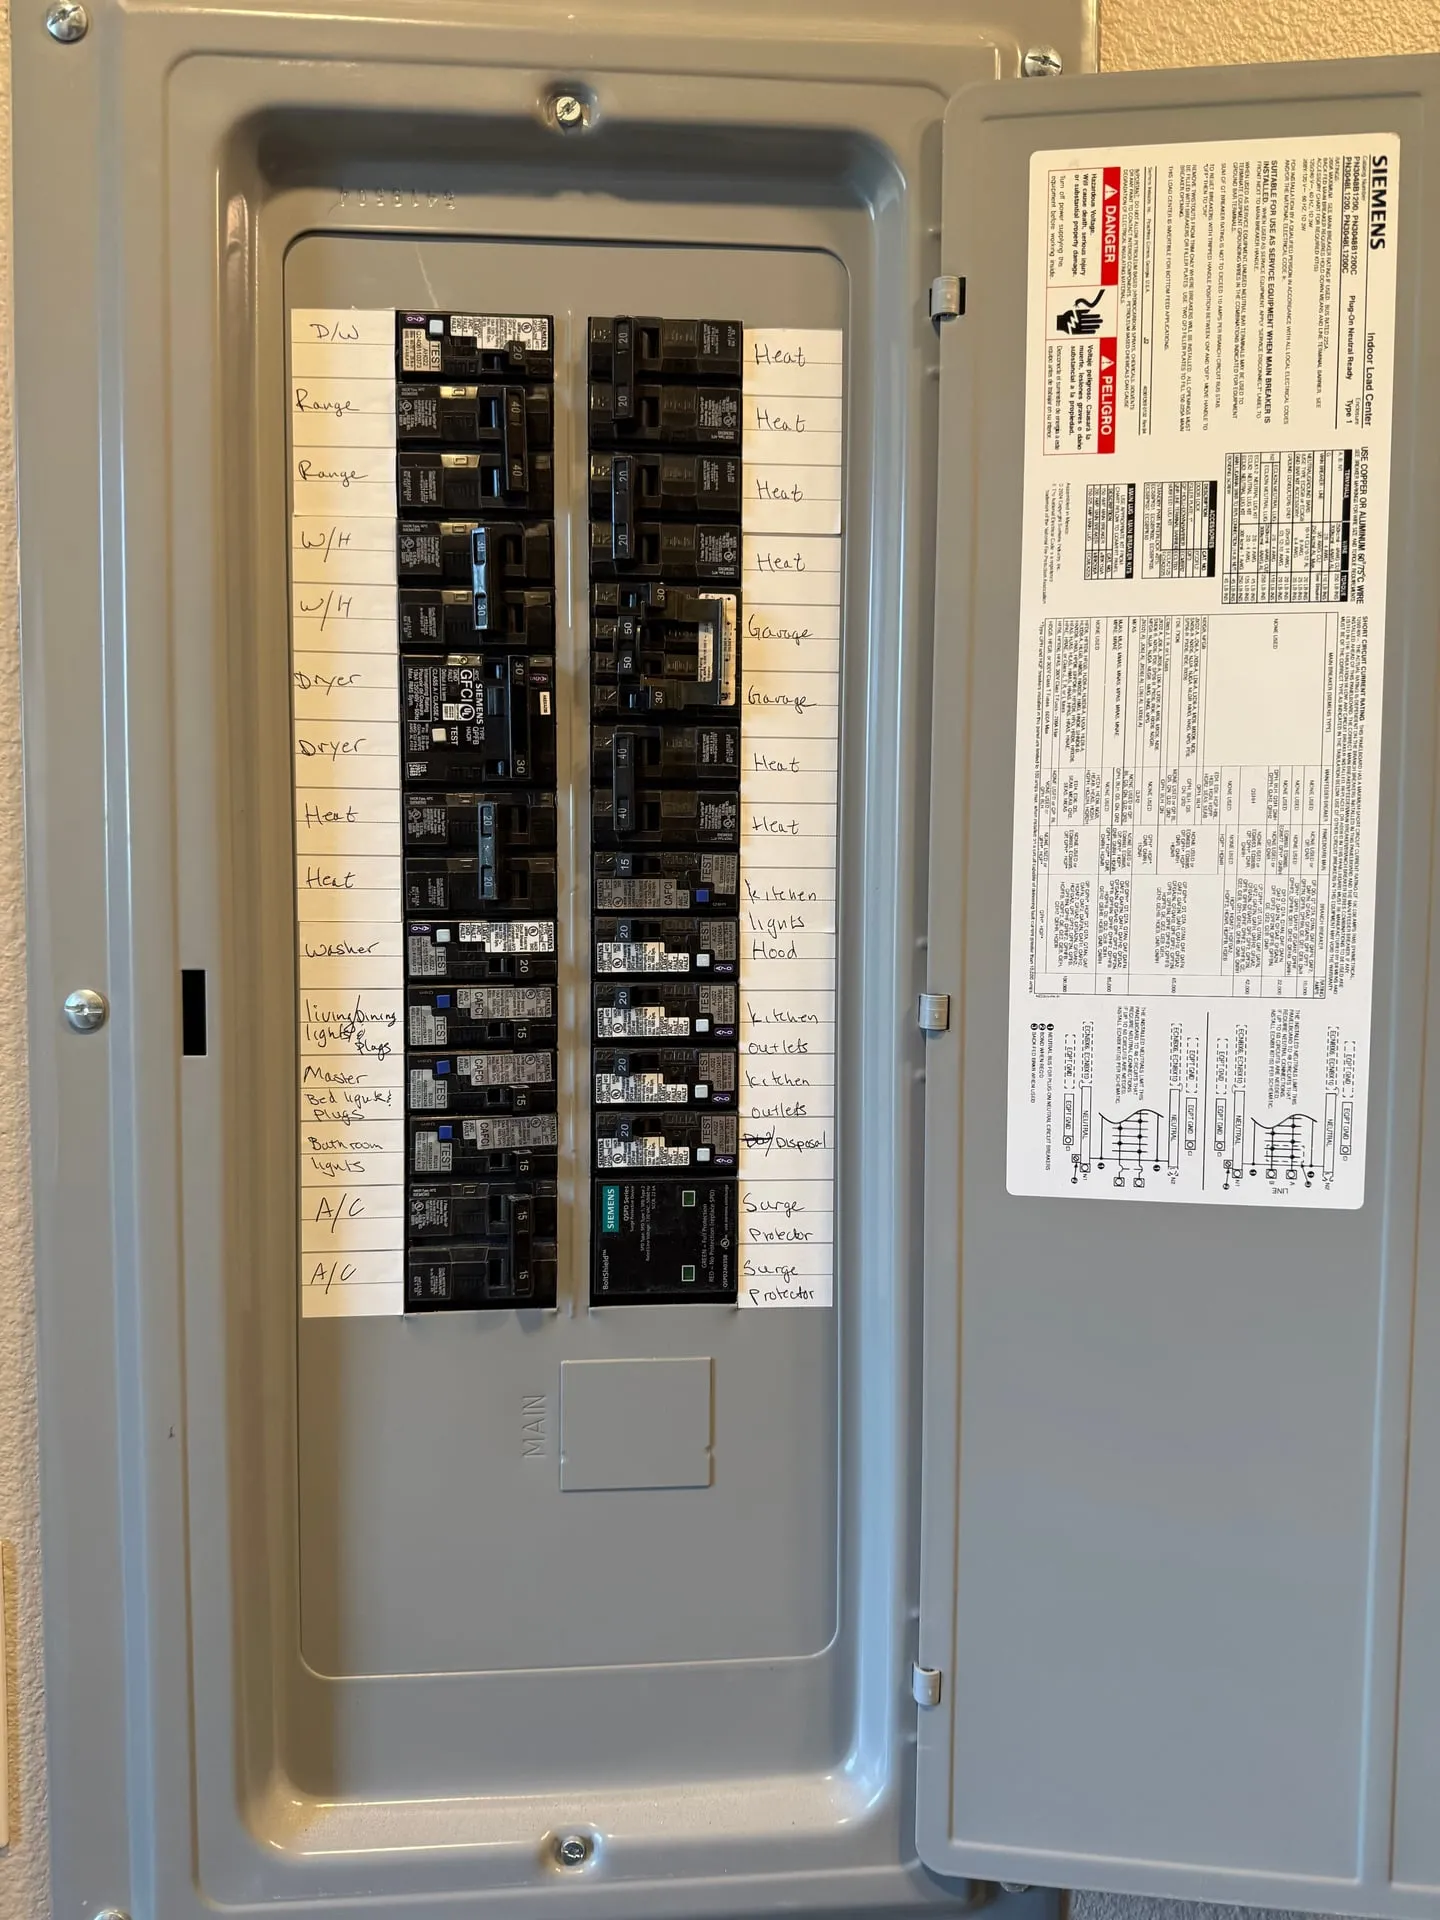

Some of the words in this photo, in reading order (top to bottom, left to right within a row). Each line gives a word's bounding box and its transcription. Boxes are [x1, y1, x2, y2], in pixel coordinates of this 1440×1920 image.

[1262, 161, 1270, 204] INSTALLED.
[1270, 160, 1278, 198] SUITABLE
[1370, 155, 1388, 250] SIEMENS
[1080, 210, 1088, 230] death,
[1269, 218, 1277, 234] USE
[1071, 221, 1080, 247] property
[1105, 205, 1116, 263] DANGER
[1269, 235, 1276, 246] AS
[1071, 250, 1079, 277] damage.
[1268, 248, 1276, 281] SERVICE
[1266, 283, 1275, 328] EQUIPMENT
[1347, 295, 1356, 326] Plug-On
[310, 322, 359, 340] D/W
[618, 332, 628, 344] 20
[1347, 327, 1355, 355] Neutral
[432, 344, 440, 370] TEST
[513, 345, 523, 360] 20
[755, 343, 806, 367] Heat
[1077, 345, 1085, 370] muerte,
[1085, 345, 1093, 367] Voltaje
[1366, 332, 1375, 364] Indoor
[1346, 357, 1354, 380] Ready
[1365, 367, 1375, 391] Load
[1085, 369, 1093, 401] peligroso.
[296, 388, 360, 418] Range
[511, 401, 521, 413] 40
[618, 395, 627, 407] 20
[1101, 375, 1113, 435] PELIGRO
[1345, 400, 1353, 417] Type
[1364, 394, 1374, 425] Center
[757, 407, 805, 433] Heat
[1068, 400, 1076, 435] propiedad.
[1076, 402, 1084, 424] graves
[1085, 404, 1093, 431] Causará
[1360, 446, 1368, 461] USE
[299, 461, 368, 487] Range
[513, 464, 522, 476] 40
[618, 470, 627, 482] 20
[1359, 463, 1368, 493] COPPER
[757, 479, 803, 502] Heat
[1359, 496, 1367, 508] OR
[618, 534, 628, 546] 20
[1358, 511, 1366, 551] ALUMINUM
[301, 527, 351, 562] W/H
[478, 540, 485, 552] 30
[757, 553, 806, 573] Heat
[657, 588, 665, 600] 30
[1356, 585, 1365, 604] WIRE
[478, 605, 486, 616] 30
[624, 622, 632, 634] 50
[748, 614, 814, 645] Garage
[516, 662, 524, 675] 30
[623, 656, 632, 668] 50
[294, 671, 362, 695] Dryer
[460, 669, 472, 702] GFCI
[655, 692, 663, 703] 30
[748, 685, 817, 714] Garage
[299, 739, 366, 762] Dryer
[618, 748, 627, 759] 40
[516, 760, 525, 773] 30
[754, 753, 800, 773] Heat
[305, 803, 358, 828] Heat
[484, 815, 492, 825] 20
[618, 808, 627, 818] 40
[752, 816, 800, 834] Heat
[620, 859, 629, 870] 15
[703, 856, 711, 880] TEST
[306, 867, 355, 889] Heat
[484, 876, 492, 887] 20
[664, 882, 672, 906] CAFCI
[620, 925, 628, 938] 20
[701, 922, 709, 946] TEST
[753, 939, 797, 960] Hood
[520, 960, 528, 972] 20
[474, 992, 484, 1016] CAFCI
[619, 991, 627, 1004] 20
[700, 986, 709, 1010] TEST
[437, 1018, 446, 1043] TEST
[518, 1026, 526, 1038] 15
[304, 1066, 368, 1084] Master
[474, 1058, 484, 1082] CAFCI
[618, 1058, 626, 1071] 20
[304, 1089, 337, 1105] Bed
[437, 1082, 446, 1108] TEST
[517, 1094, 526, 1106] 15
[480, 1122, 489, 1147] CAFCI
[621, 1124, 629, 1137] 20
[442, 1144, 451, 1170] TEST
[520, 1160, 528, 1171] 15
[316, 1193, 365, 1233] A/C
[518, 1211, 527, 1220] 15
[607, 1189, 615, 1229] SIEMENS
[742, 1192, 805, 1218] Surge
[749, 1229, 813, 1242] Protector
[311, 1261, 357, 1294] A/C
[520, 1270, 528, 1279] 15
[743, 1261, 799, 1283] Surge
[749, 1288, 815, 1305] Protector
[521, 1394, 547, 1457] MAIN
